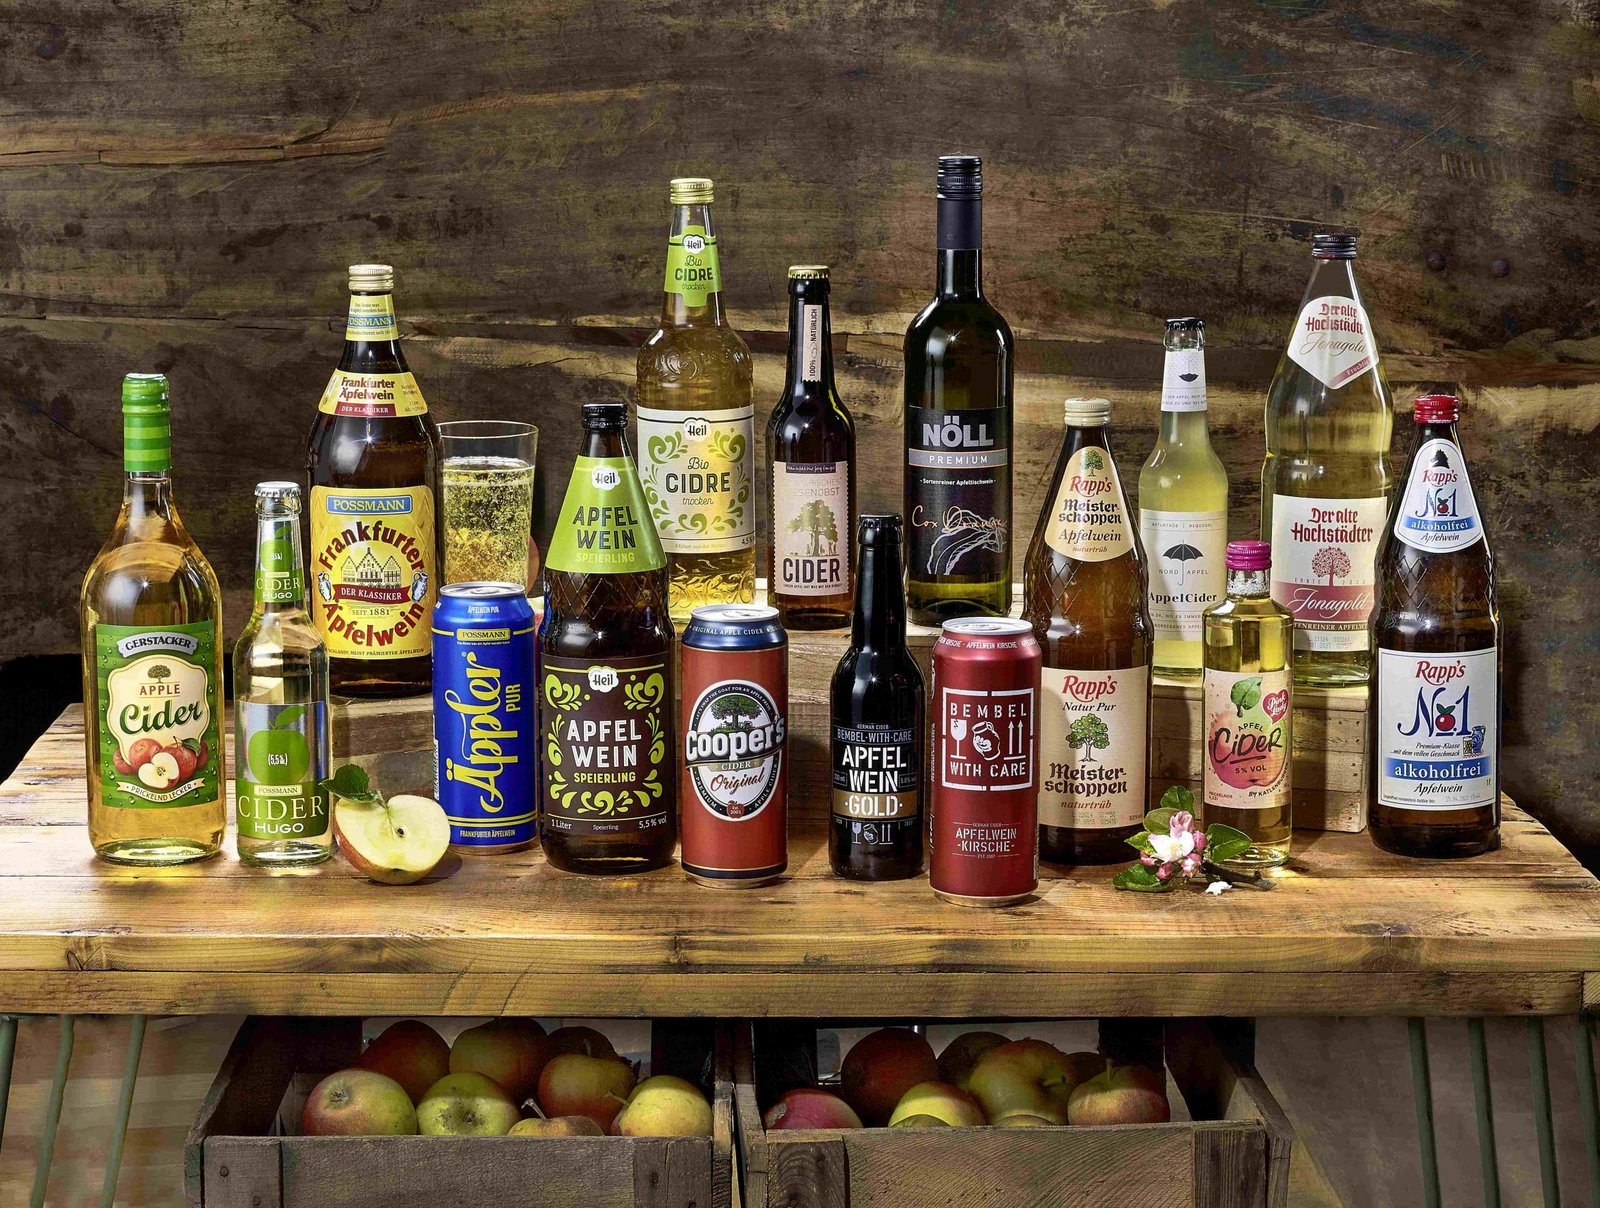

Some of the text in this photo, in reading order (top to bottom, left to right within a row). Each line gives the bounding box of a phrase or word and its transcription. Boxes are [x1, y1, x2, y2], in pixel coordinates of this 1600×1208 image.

[686, 240, 702, 249] Heil
[684, 255, 703, 266] Bio
[674, 267, 714, 281] CIDRE
[1305, 316, 1364, 335] Hochstädte
[341, 376, 395, 388] Frankfurter
[339, 387, 394, 401] Äpfelwein
[687, 425, 707, 436] Heil
[922, 415, 994, 448] NÖLL
[687, 457, 709, 470] Bio
[929, 455, 988, 465] PREMIUM
[595, 472, 616, 484] Heil
[665, 472, 731, 494] CIDRE
[922, 478, 994, 486] Sortenreiner Apfeltischwein
[1422, 469, 1458, 487] Rapp's
[1069, 475, 1113, 497] Rapp's
[333, 499, 405, 512] POSSMANN
[682, 496, 714, 505] trocken
[1063, 498, 1120, 513] Meister-
[572, 506, 638, 527] APFEL
[911, 505, 938, 527] Cox
[1058, 511, 1122, 526] schoppen
[1289, 521, 1374, 543] Hochstädter
[1411, 519, 1469, 531] alkoholfrei
[577, 529, 637, 550] WEIN
[1058, 528, 1122, 544] Apfelwein
[1420, 532, 1460, 544] Apfelwein
[318, 520, 425, 571] Frankfurter
[575, 552, 635, 563] SPEIERLING
[783, 558, 841, 583] CIDER
[255, 577, 301, 590] CIDER
[262, 591, 293, 599] HUGO
[341, 587, 402, 600] DER KLASSIKER
[1148, 592, 1217, 605] AppelCider
[1287, 587, 1370, 619] Jonagold
[369, 608, 391, 616] 1881
[322, 599, 425, 647] Äpfelwein
[692, 625, 718, 635] ORIGINAL
[1294, 622, 1368, 631] TENREINER APFELWE
[125, 634, 191, 651] GERSTACKER
[966, 641, 995, 649] APFELWEIN
[996, 641, 1018, 649] KIRSCHE
[592, 673, 613, 686] Heil
[1415, 660, 1466, 686] Rapp's
[139, 684, 181, 696] APPLE
[1062, 675, 1118, 703] Rapp's
[505, 683, 521, 712] PUR
[1267, 692, 1286, 711] Pink
[950, 702, 1027, 718] BEMBEL
[1062, 701, 1117, 712] Natur Pur
[1270, 702, 1288, 717] Lady
[119, 699, 203, 735] Cider
[444, 651, 519, 813] Äppler
[566, 719, 642, 742] APFEL
[1238, 722, 1264, 733] APFEL
[685, 714, 785, 762] Cooper's
[1416, 742, 1461, 750] Premium-Klasse
[1429, 749, 1461, 757] Geschmack
[571, 744, 637, 768] WEIN
[842, 745, 907, 769] APFEL
[721, 761, 751, 771] CIDER
[950, 761, 1026, 777] WITH CARE
[1049, 762, 1127, 781] Meister-
[1250, 764, 1267, 772] VOL
[1394, 762, 1481, 779] alkoholfrei
[573, 771, 636, 784] SPEIERLING
[710, 766, 765, 795] Original
[848, 769, 898, 793] WEIN
[130, 784, 193, 801] PRICKELND LECKER
[258, 786, 298, 794] POSSMANN
[695, 776, 717, 808] PREMIUM
[754, 763, 778, 808] APPLE CIDER
[1044, 779, 1128, 798] schoppen
[1413, 783, 1463, 796] Apfelwein
[238, 795, 324, 820] CIDER
[848, 795, 899, 816] GOLD
[1060, 800, 1112, 809] naturtrüb
[254, 821, 304, 834] HUGO
[551, 819, 572, 830] 1 Liter
[638, 820, 651, 829] 5,5
[658, 815, 667, 824] vol
[459, 828, 516, 838] FRANKFURTER ÄPFELWEIN
[955, 827, 1017, 840] APFELWEIN
[961, 840, 1011, 852] KIRSCHE
